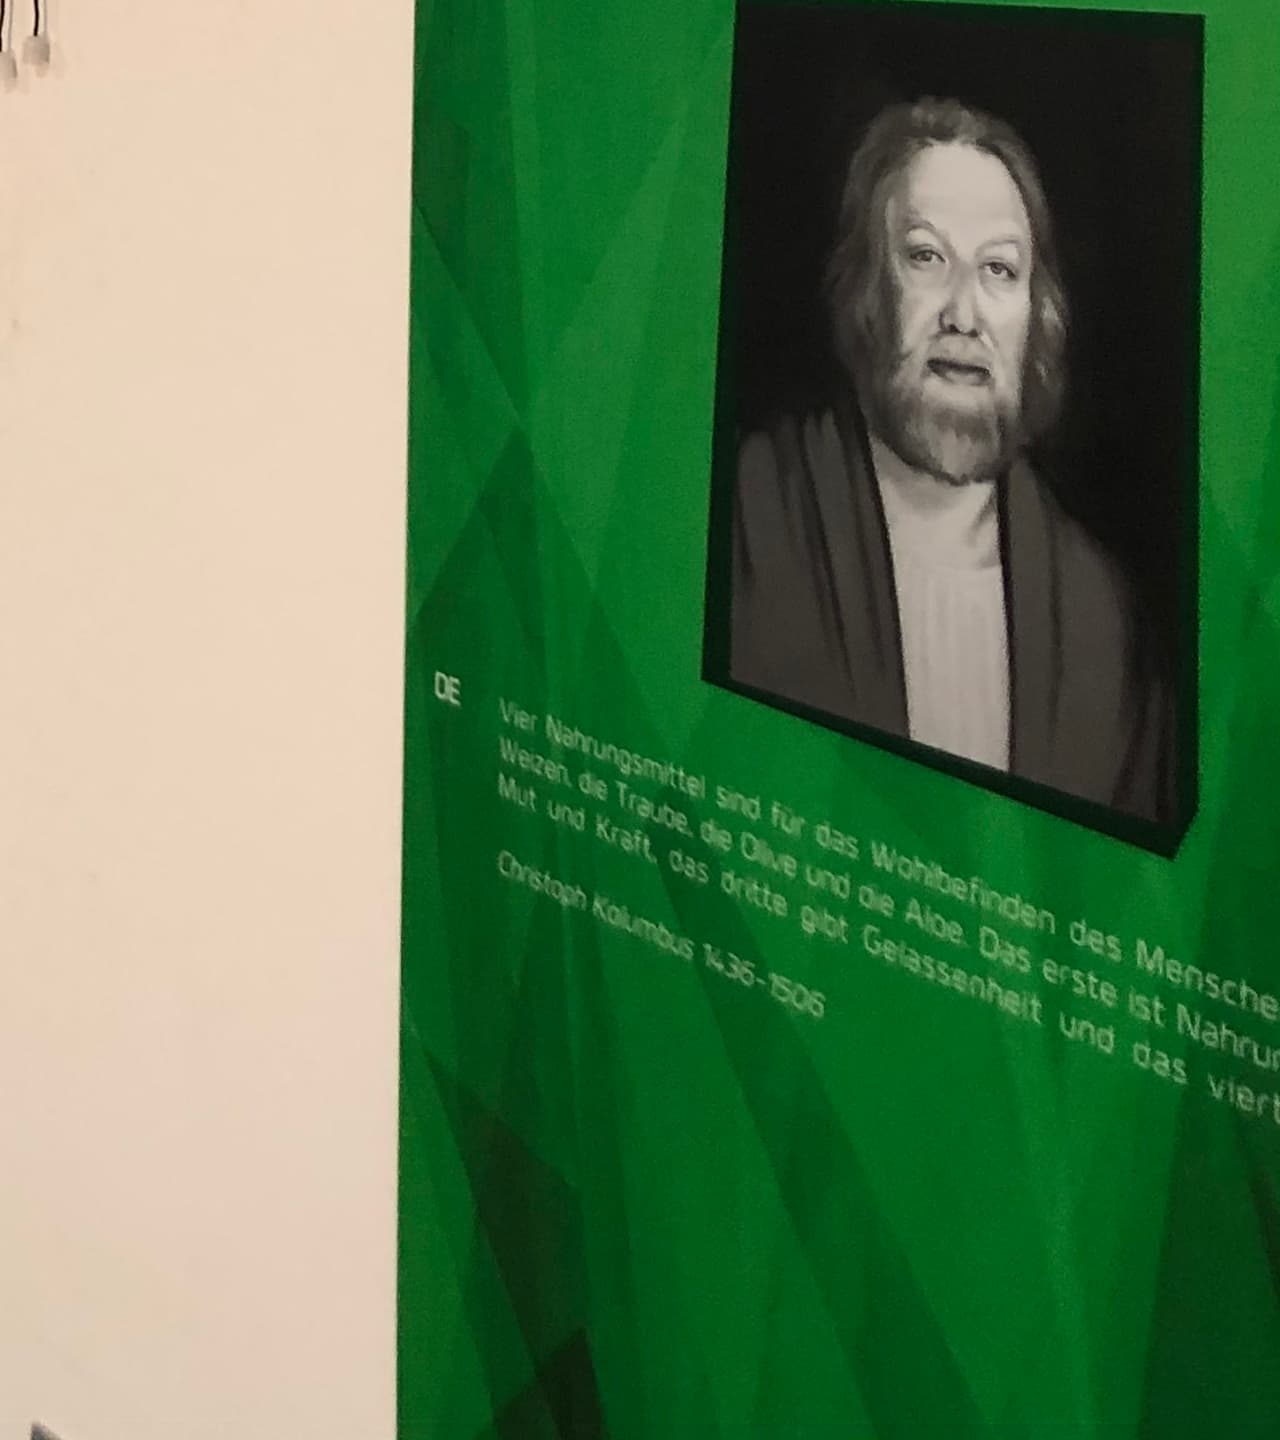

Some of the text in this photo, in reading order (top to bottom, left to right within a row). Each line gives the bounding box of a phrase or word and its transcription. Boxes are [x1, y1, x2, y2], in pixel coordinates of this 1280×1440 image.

[434, 671, 462, 706] DE
[498, 771, 538, 813] Mut
[547, 799, 586, 832] und
[595, 812, 659, 865] Kraft,
[668, 848, 709, 885] das
[720, 867, 789, 918] dritte
[800, 903, 849, 945] gibt
[862, 924, 1042, 1025] Gelassenheit
[1058, 1010, 1114, 1056] und
[1132, 1039, 1188, 1086] das
[498, 850, 827, 1019] Christoph Kolumbus 1436-1506
[499, 696, 539, 733] Vier
[545, 714, 707, 801] Nahrungsmittel
[716, 784, 762, 822] sind
[771, 800, 806, 838] für
[814, 821, 861, 860] das
[871, 840, 1057, 936] Wohlbefinden
[1069, 919, 1123, 963] des
[578, 772, 609, 802] die
[616, 779, 695, 838] Traube,
[700, 818, 734, 853] die
[741, 831, 799, 880] Olive
[805, 862, 852, 901] und
[858, 881, 896, 918] die
[979, 926, 1033, 975] Das
[1042, 957, 1118, 1009] erste
[1128, 985, 1167, 1027] ist
